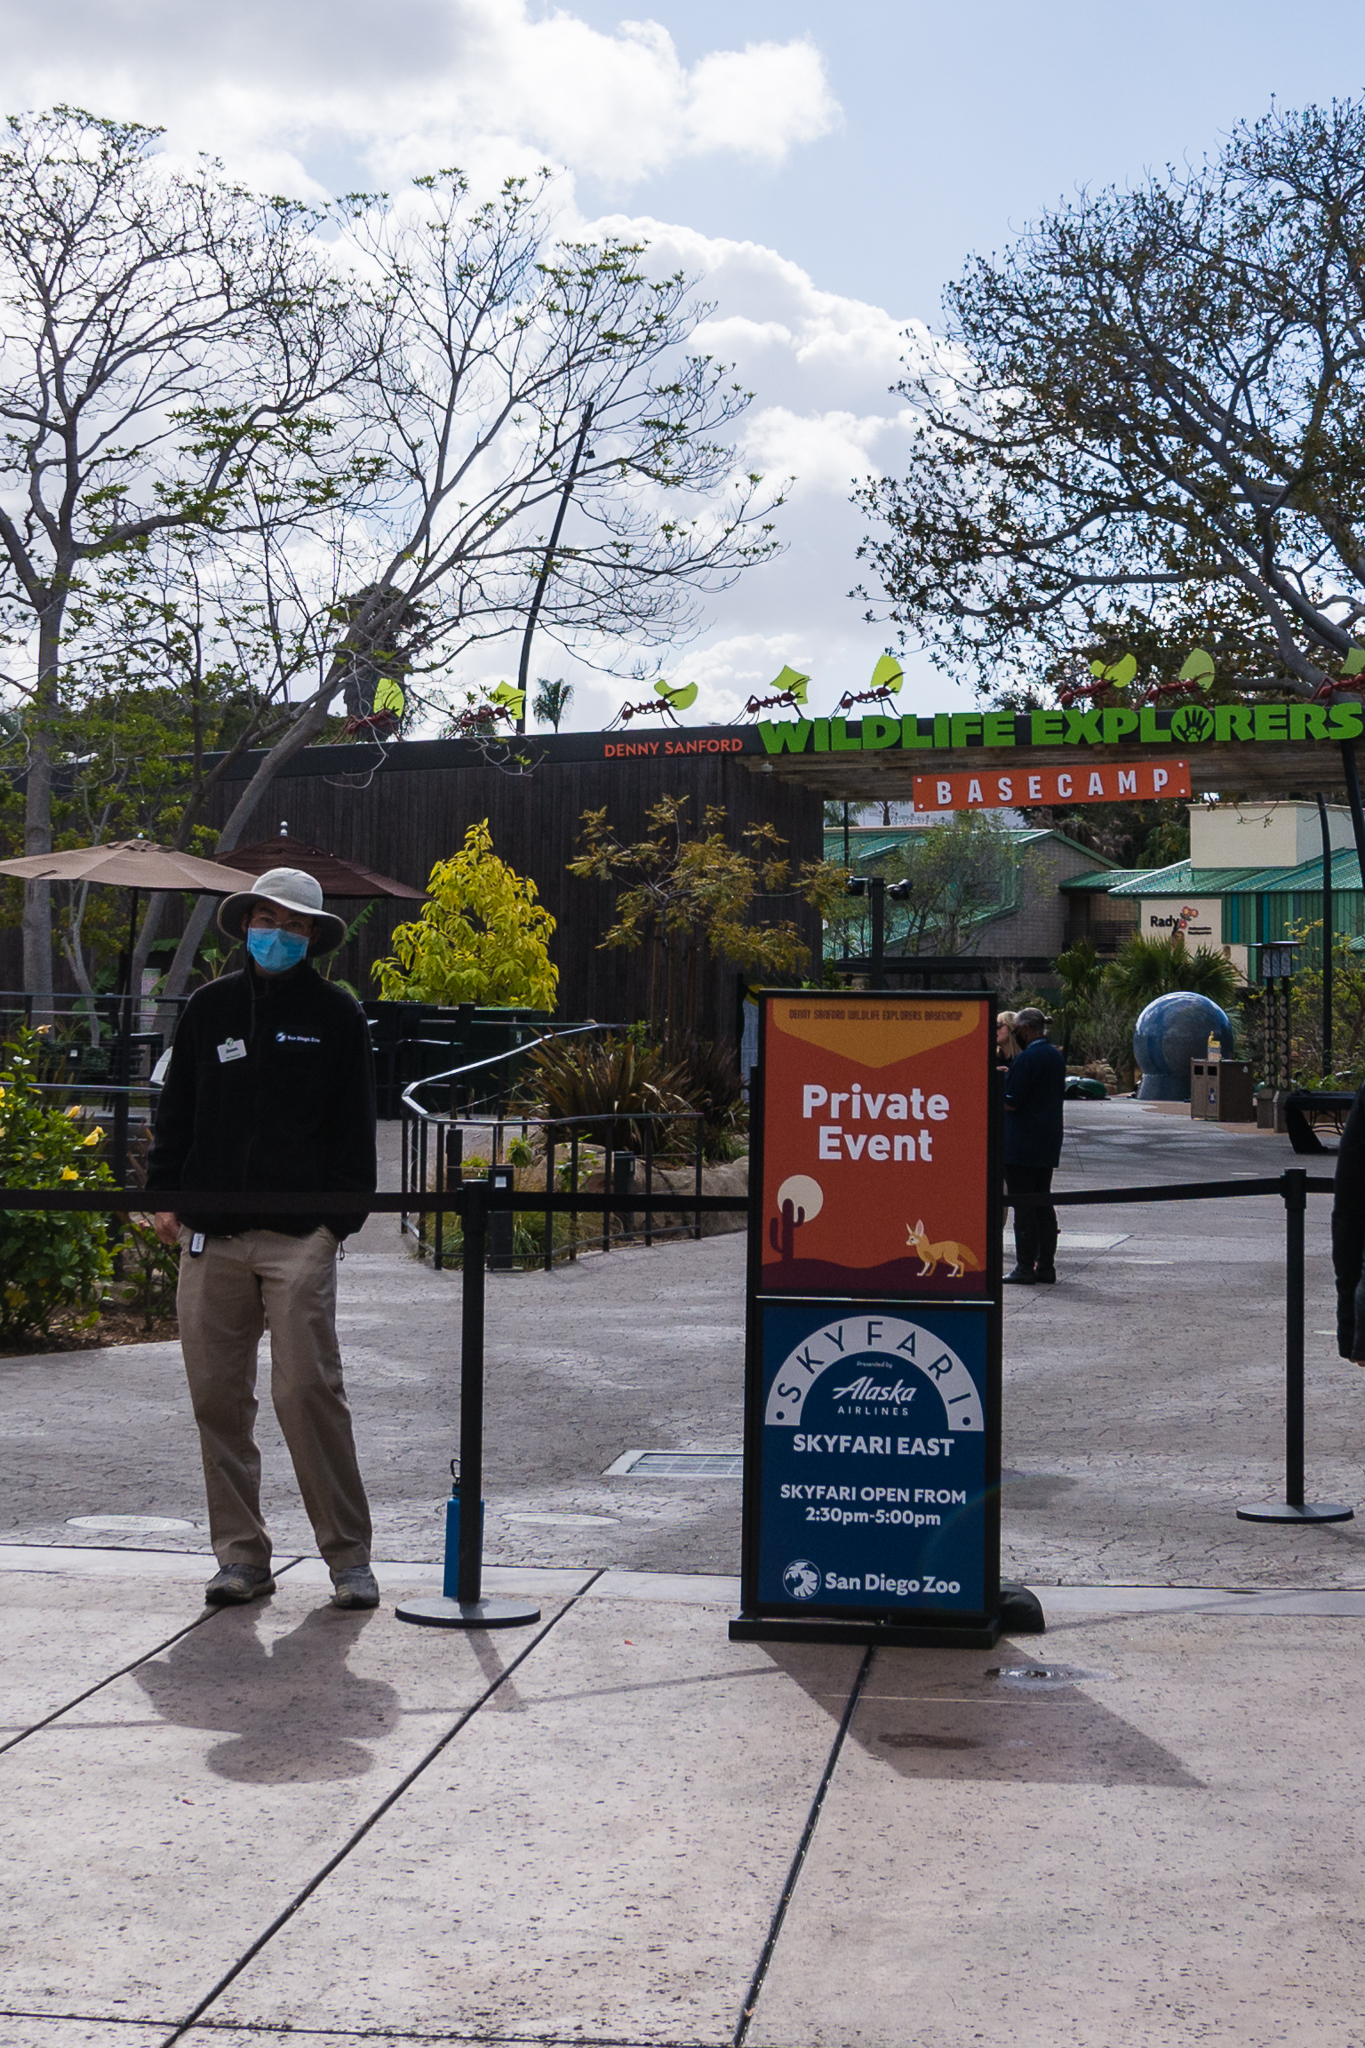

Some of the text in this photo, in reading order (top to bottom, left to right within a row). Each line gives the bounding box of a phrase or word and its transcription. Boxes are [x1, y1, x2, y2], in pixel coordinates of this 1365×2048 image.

[757, 702, 1364, 755] WILDLIFE EXPLORERS
[604, 738, 743, 758] DENNY SANFORD
[936, 768, 1169, 805] BASECAMP
[1150, 915, 1180, 935] Rady
[802, 1083, 950, 1121] Private
[819, 1125, 933, 1162] Event
[777, 1321, 972, 1405] SKYFARI
[832, 1376, 917, 1405] Alaska
[837, 1406, 909, 1416] AIRLINES
[793, 1433, 955, 1457] SKYFARI EAST
[780, 1484, 966, 1505] SKYFARI OPEN FROM
[805, 1506, 942, 1527] 2:30pm-5:00pm
[825, 1572, 961, 1596] San Diego Zoo
